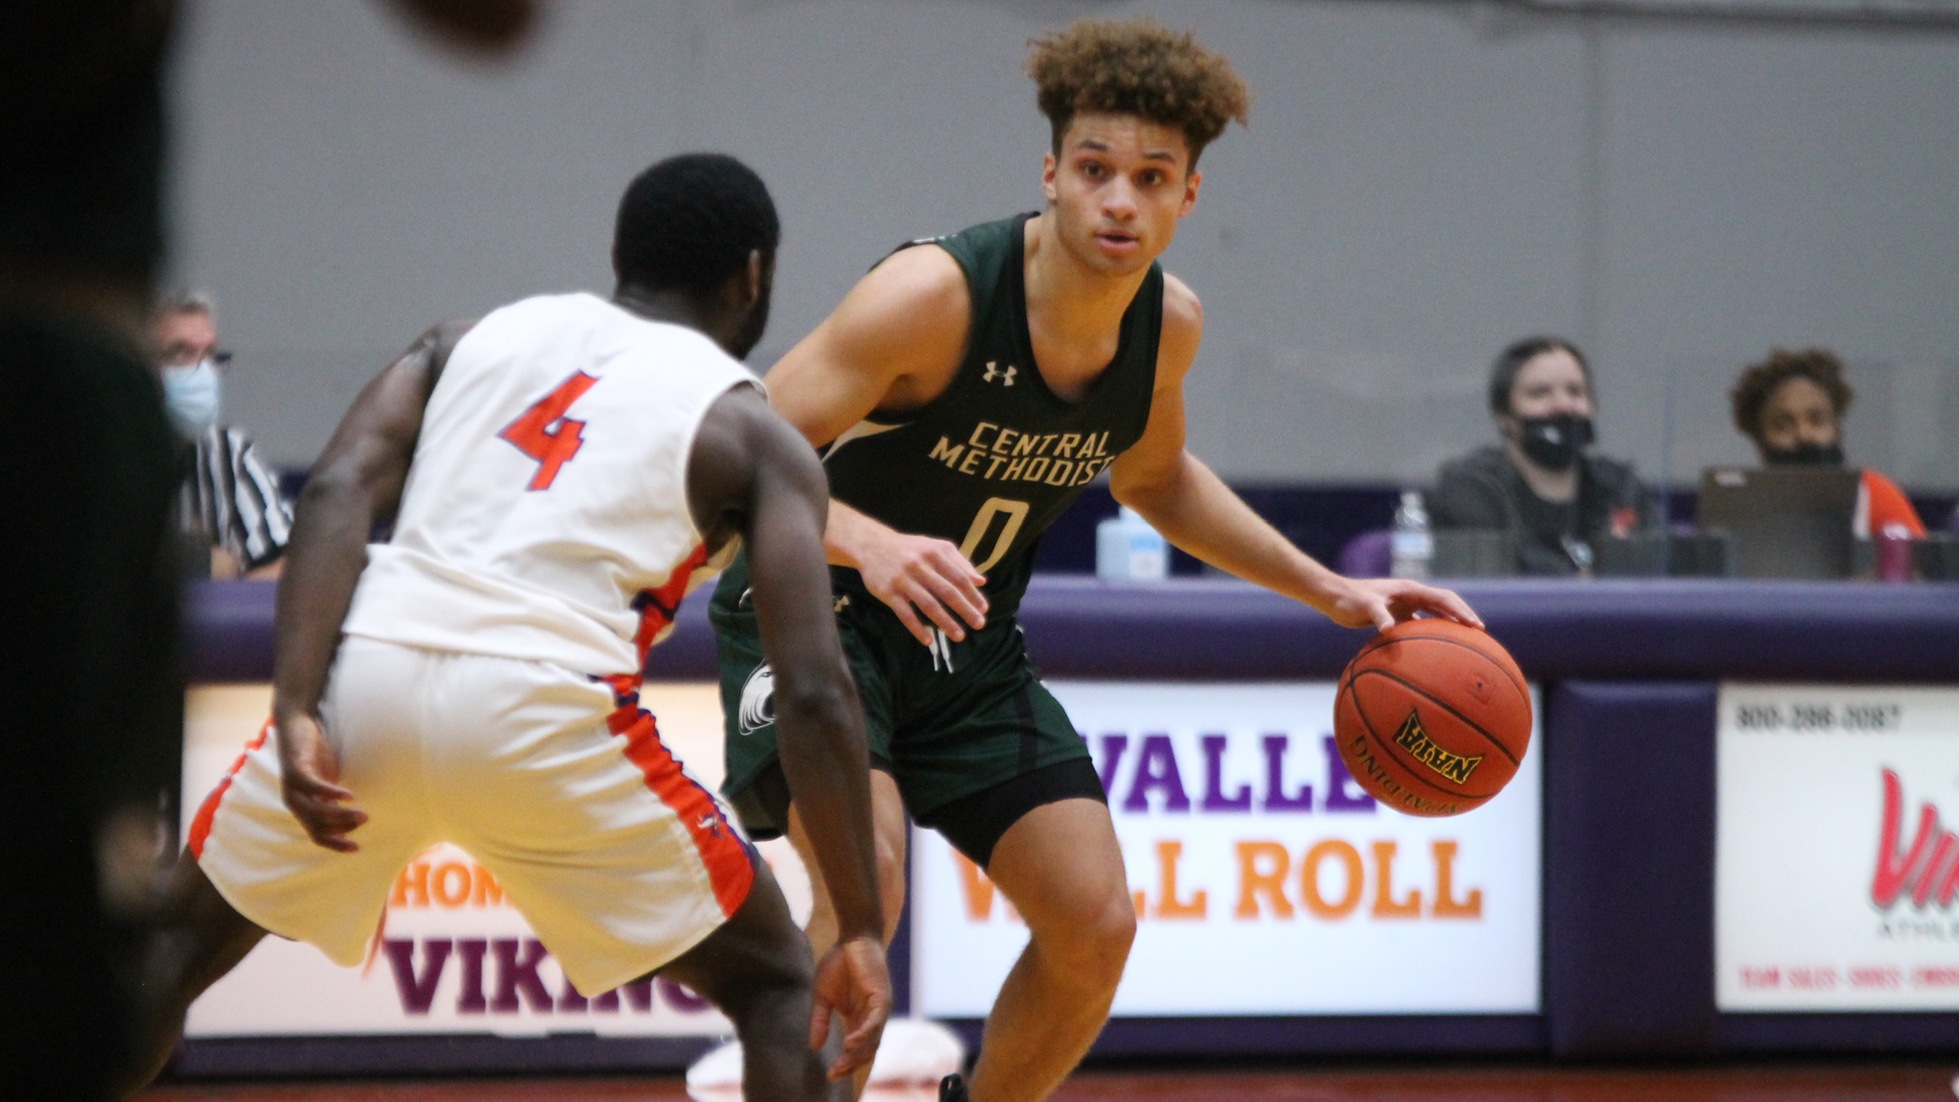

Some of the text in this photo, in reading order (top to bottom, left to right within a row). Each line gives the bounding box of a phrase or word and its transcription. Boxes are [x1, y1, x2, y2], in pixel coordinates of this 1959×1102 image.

[496, 369, 602, 491] 4
[928, 436, 1115, 487] METHODIST
[968, 421, 1110, 460] CENTRAL
[958, 497, 1030, 574] 0
[1078, 734, 1377, 813] VALLE
[1392, 708, 1485, 785] NAIA
[1233, 839, 1483, 921] ROLL
